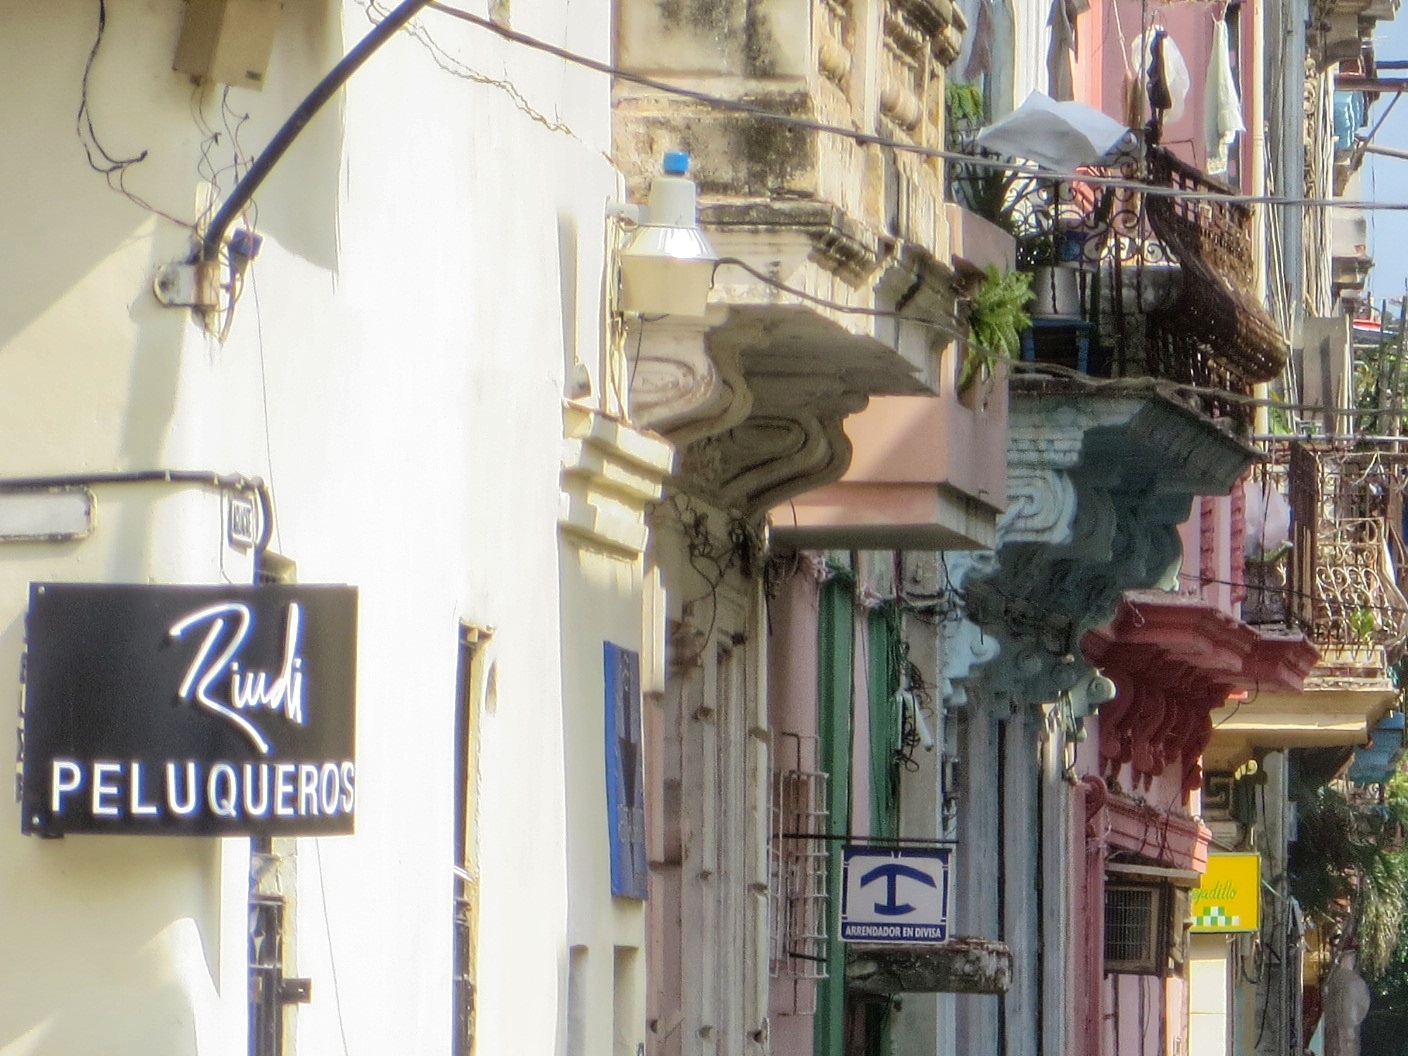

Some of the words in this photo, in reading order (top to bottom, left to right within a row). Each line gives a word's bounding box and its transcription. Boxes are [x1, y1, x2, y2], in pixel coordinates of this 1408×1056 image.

[51, 760, 356, 817] PELUQUEROS
[845, 925, 900, 937] ARRENDADOR
[902, 927, 914, 937] EN
[915, 927, 942, 938] DIVISA
